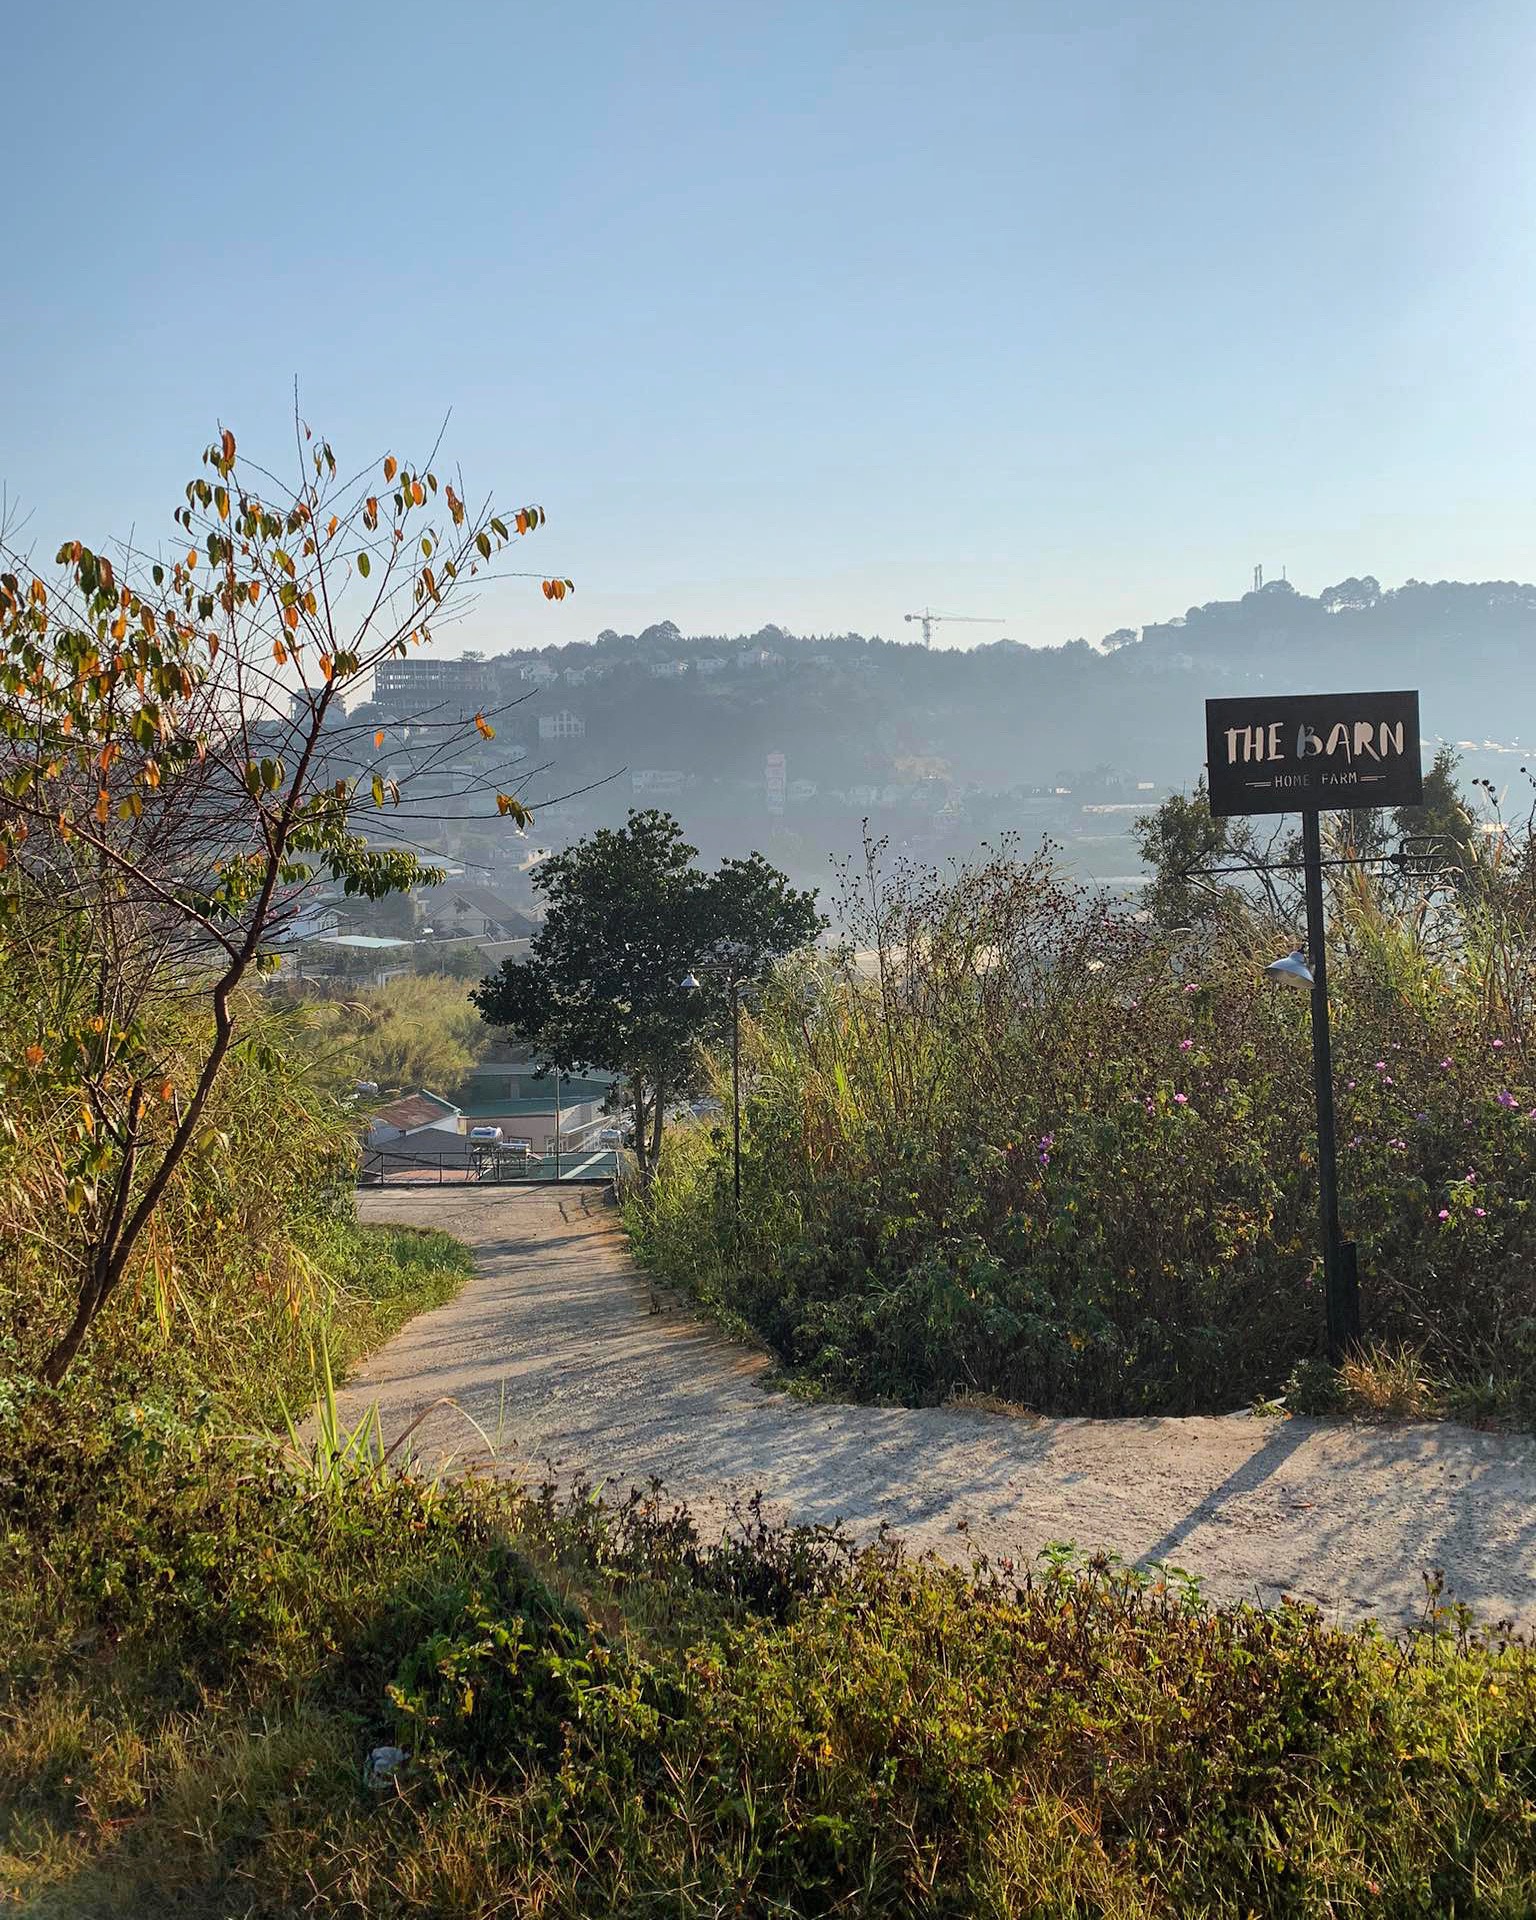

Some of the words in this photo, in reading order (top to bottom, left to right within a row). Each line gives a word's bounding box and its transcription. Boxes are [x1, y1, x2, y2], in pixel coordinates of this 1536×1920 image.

[1224, 721, 1284, 764] THE
[1297, 721, 1404, 764] BARN
[1275, 773, 1311, 788] HOME
[1321, 772, 1358, 785] FARM
